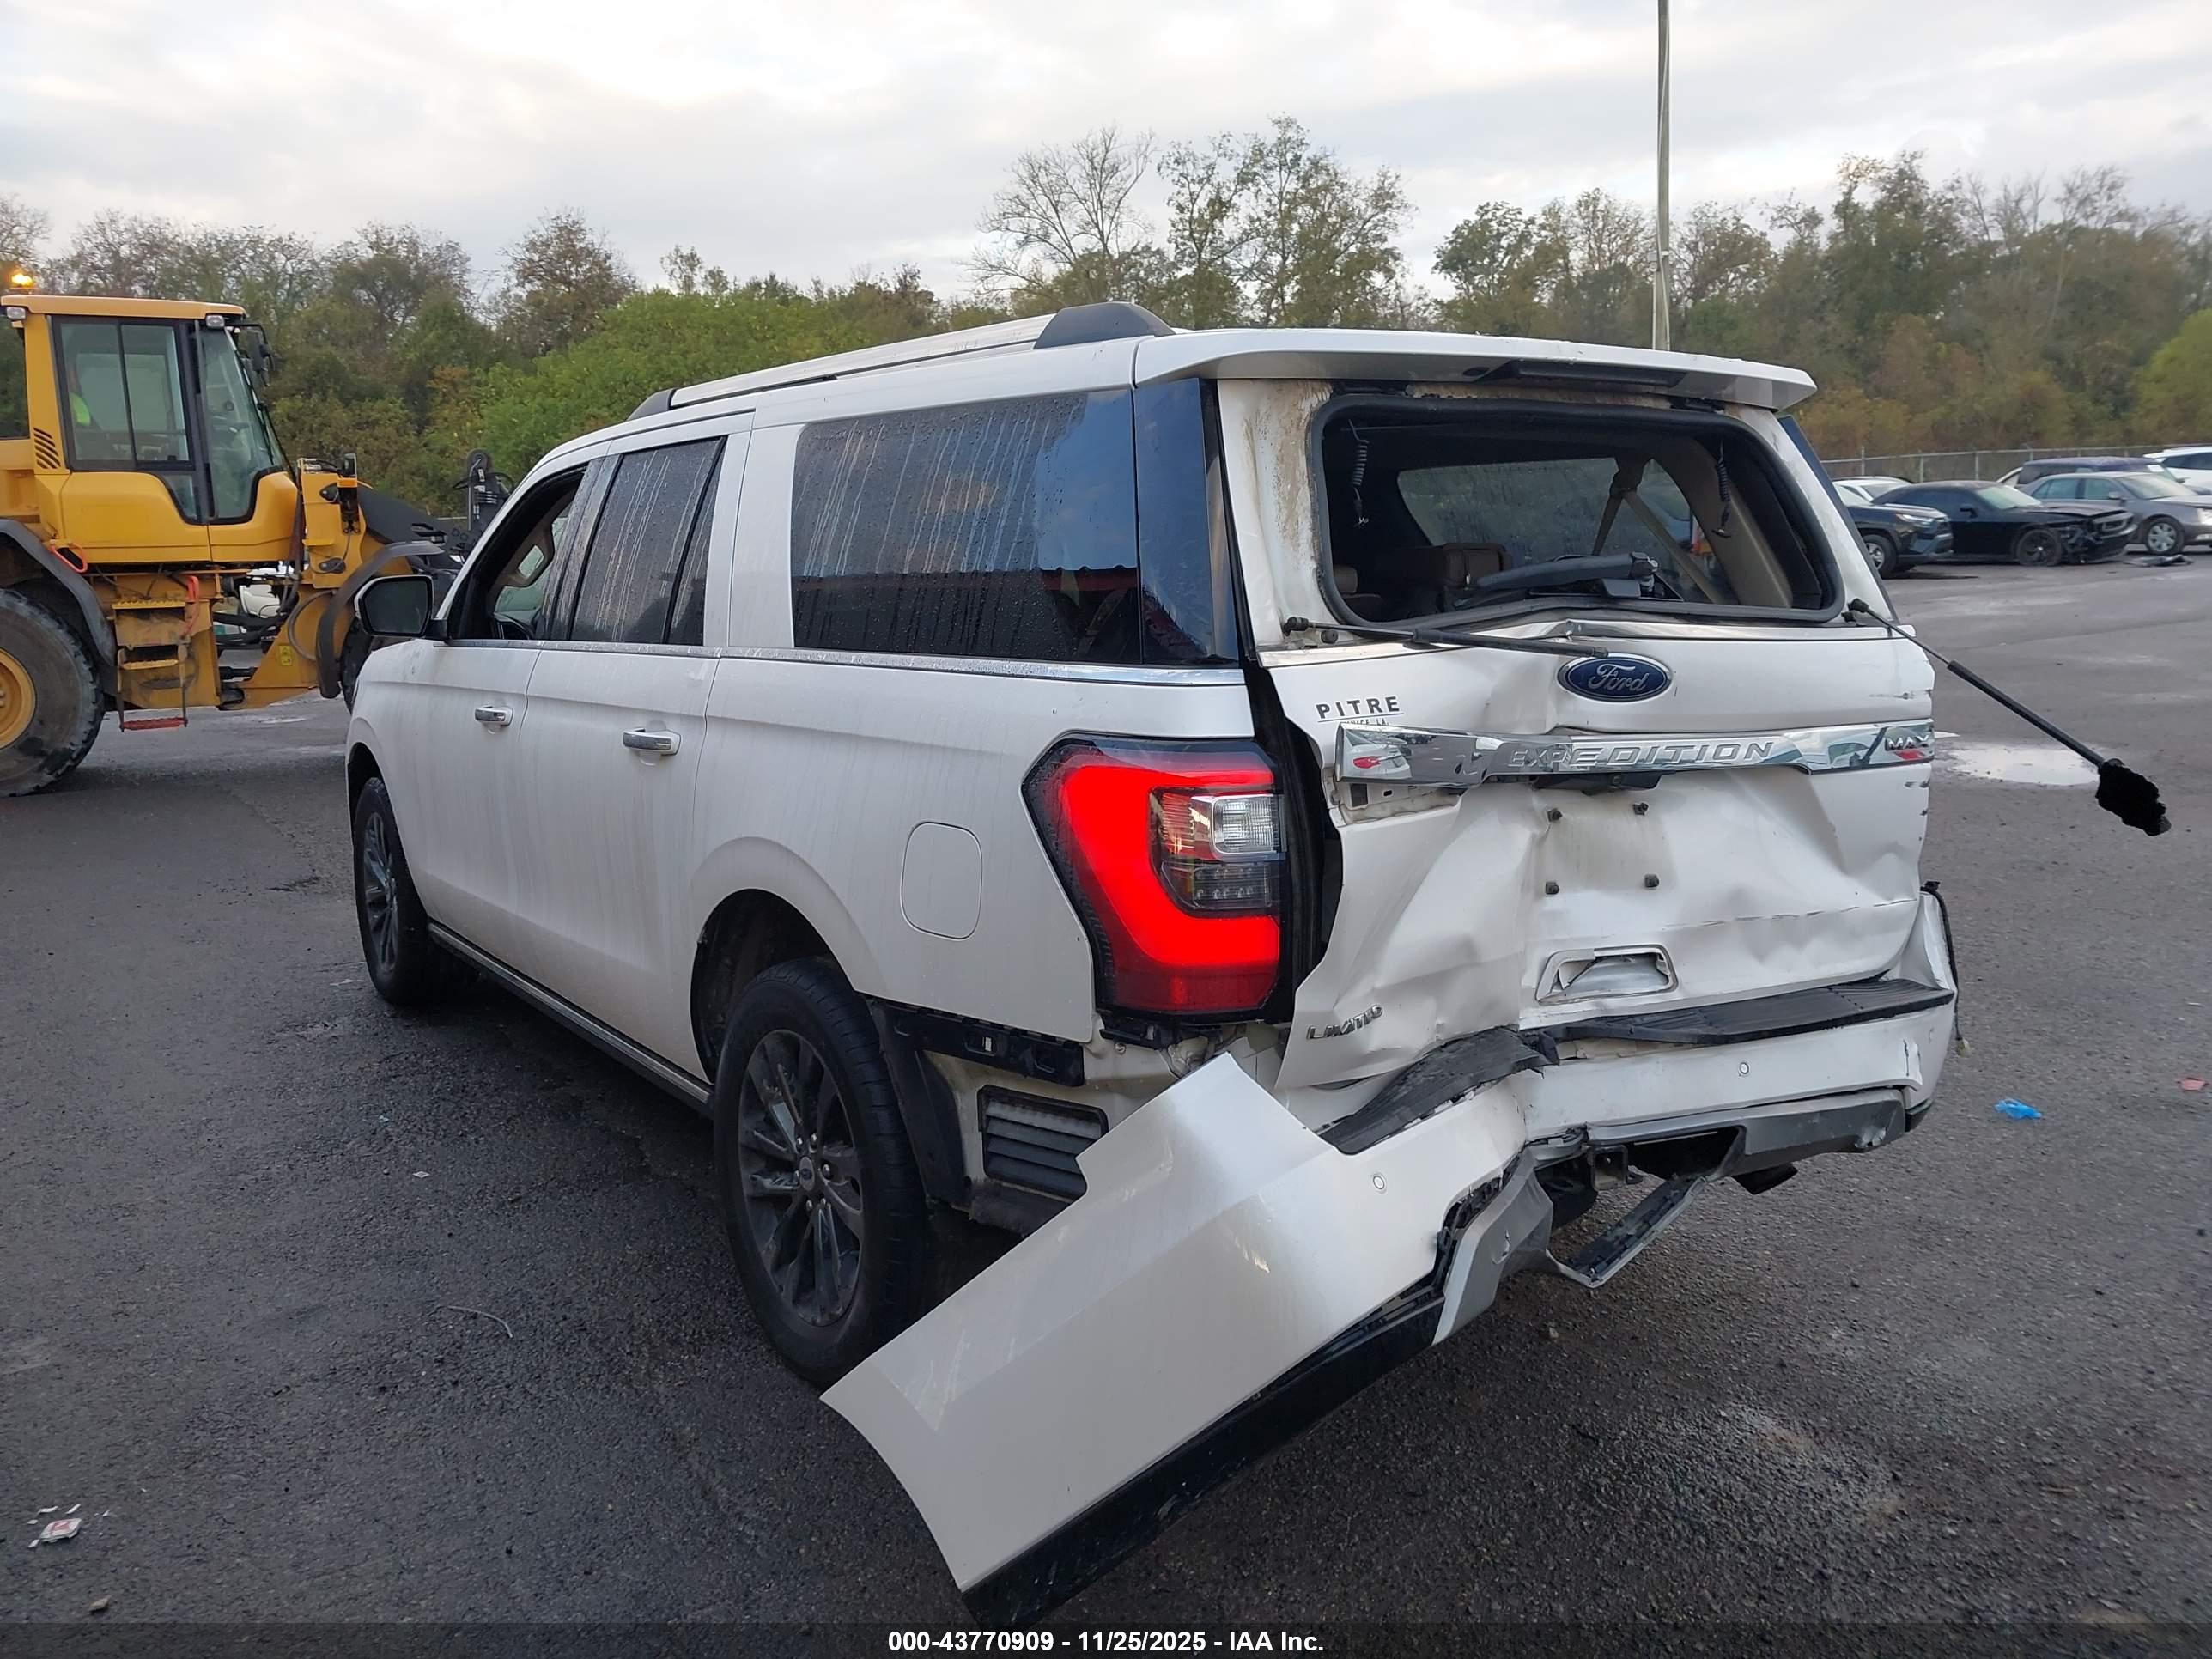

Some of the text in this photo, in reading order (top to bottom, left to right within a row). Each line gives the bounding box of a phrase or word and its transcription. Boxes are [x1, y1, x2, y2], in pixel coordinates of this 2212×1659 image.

[1588, 663, 1650, 692] Ford
[1316, 696, 1401, 720] PITRE
[1507, 741, 1774, 768] EXPEDITION
[1885, 734, 1930, 752] MAX
